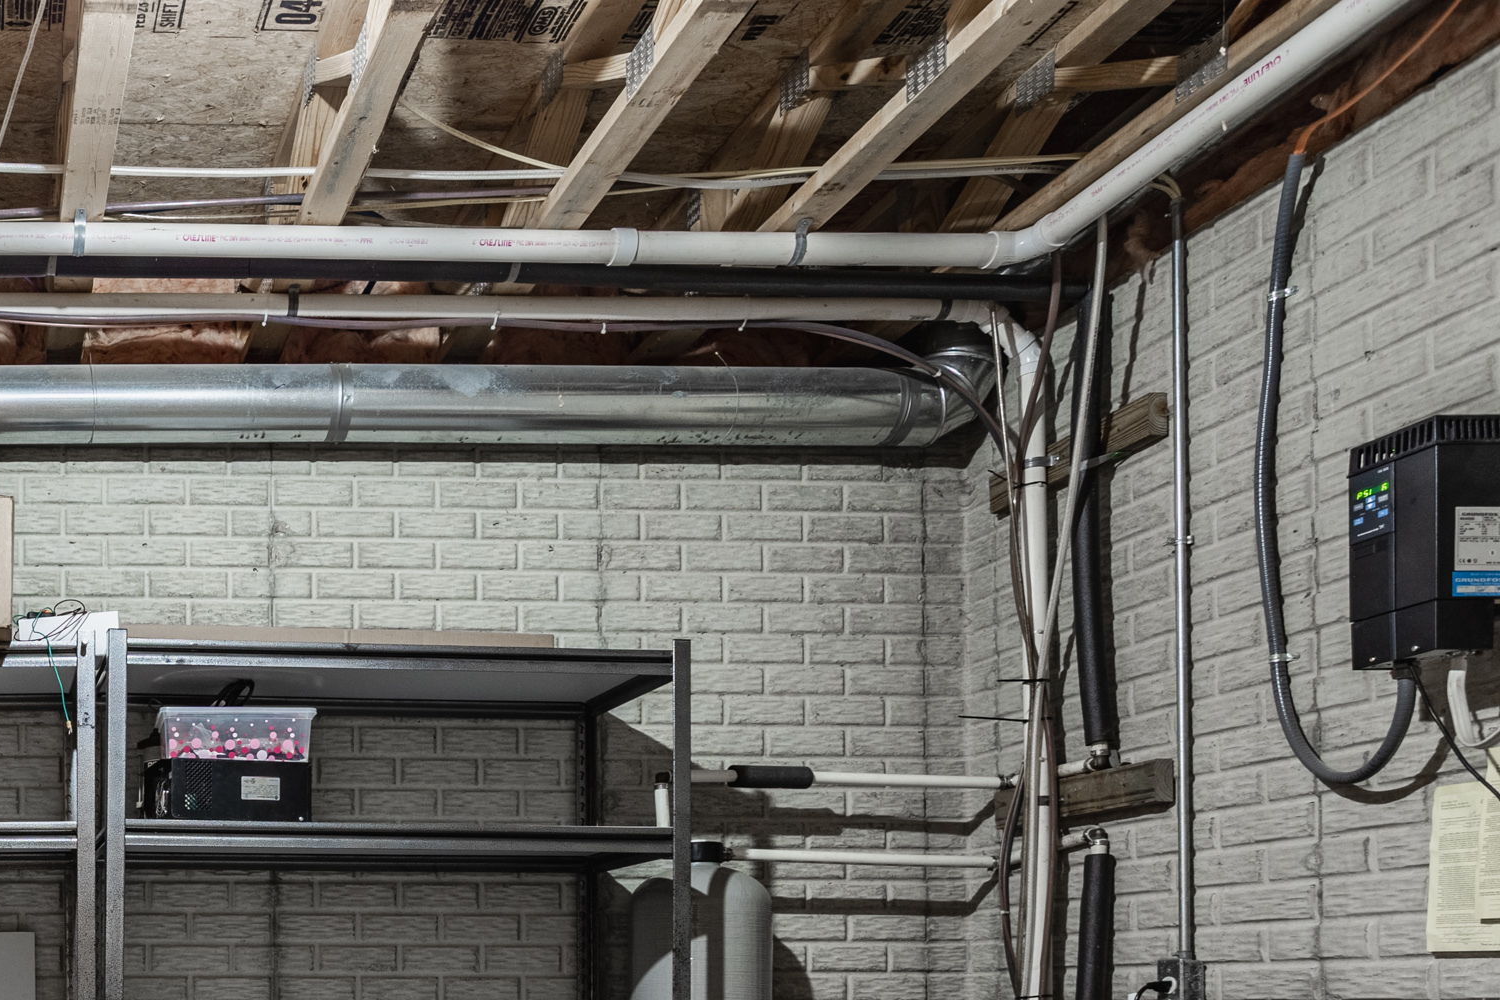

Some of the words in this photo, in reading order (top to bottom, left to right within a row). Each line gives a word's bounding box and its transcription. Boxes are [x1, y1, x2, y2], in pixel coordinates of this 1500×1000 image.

[160, 3, 179, 28] SHIFT
[182, 234, 217, 242] CRESLINE
[479, 239, 514, 247] CRESLINE
[1356, 488, 1373, 500] PSI
